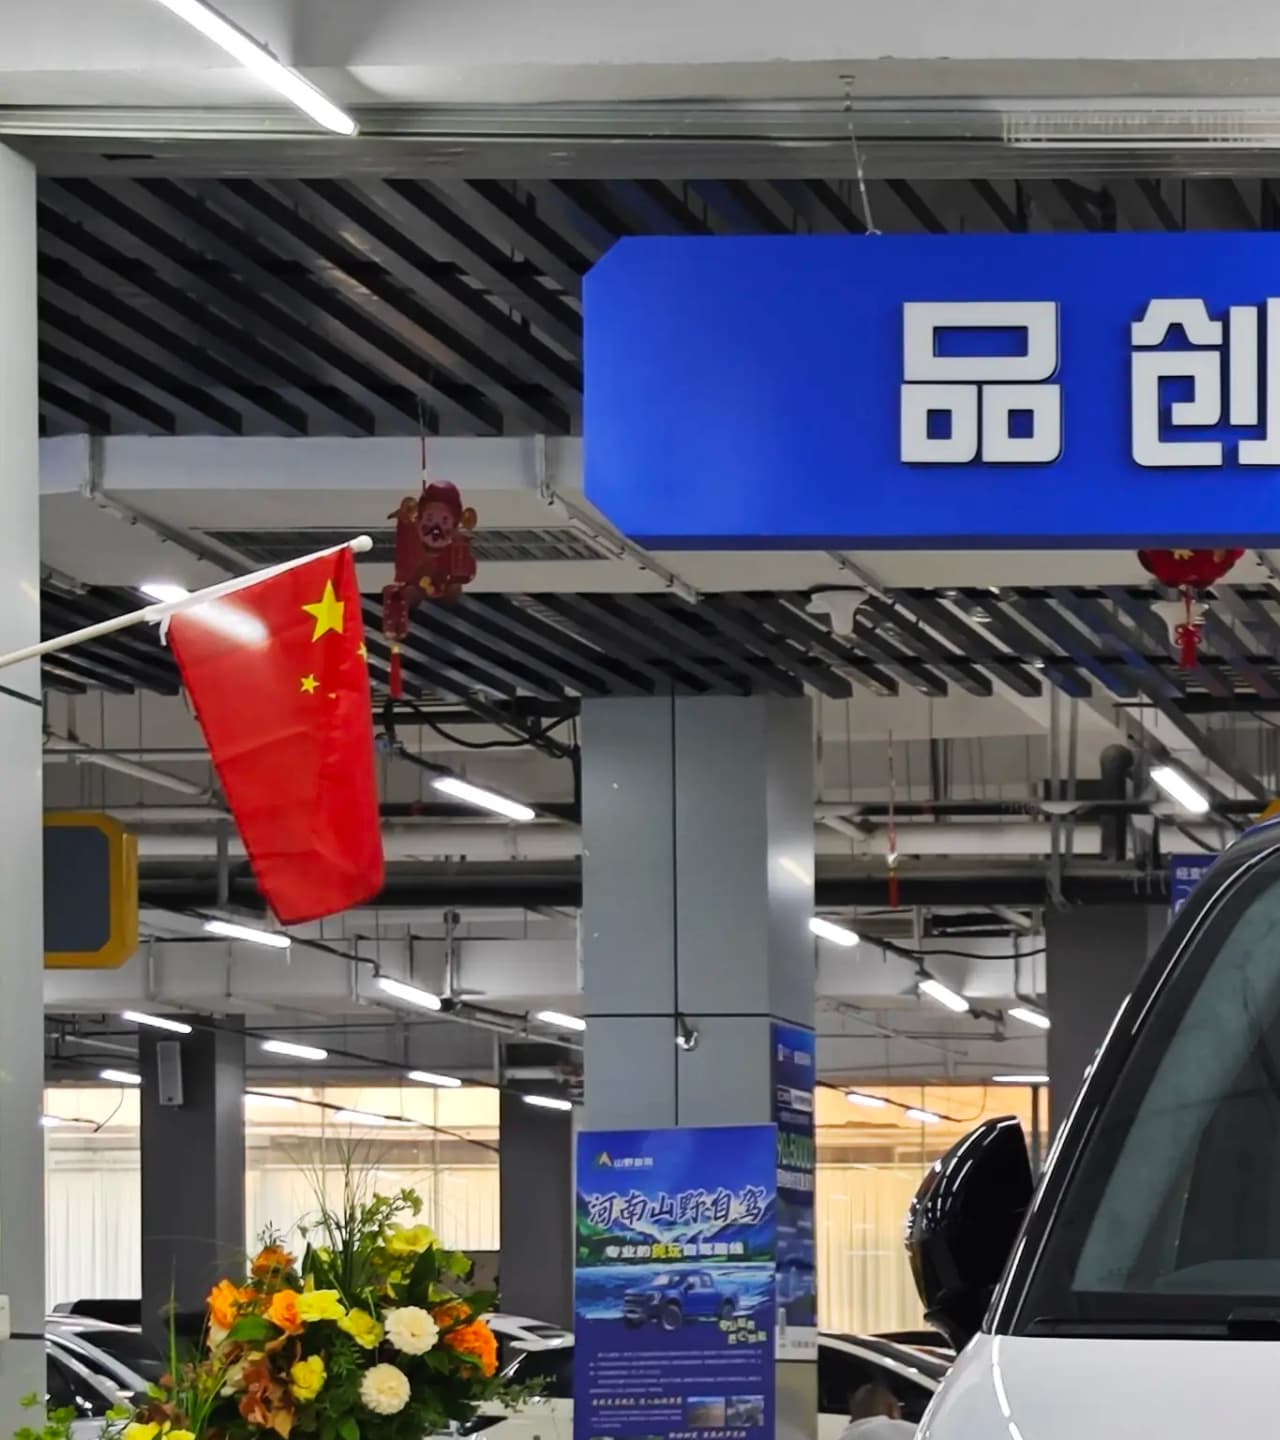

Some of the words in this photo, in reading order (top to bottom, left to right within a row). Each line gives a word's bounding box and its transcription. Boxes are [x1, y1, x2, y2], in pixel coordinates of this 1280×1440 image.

[587, 1185, 767, 1229] 河南山野自驾
